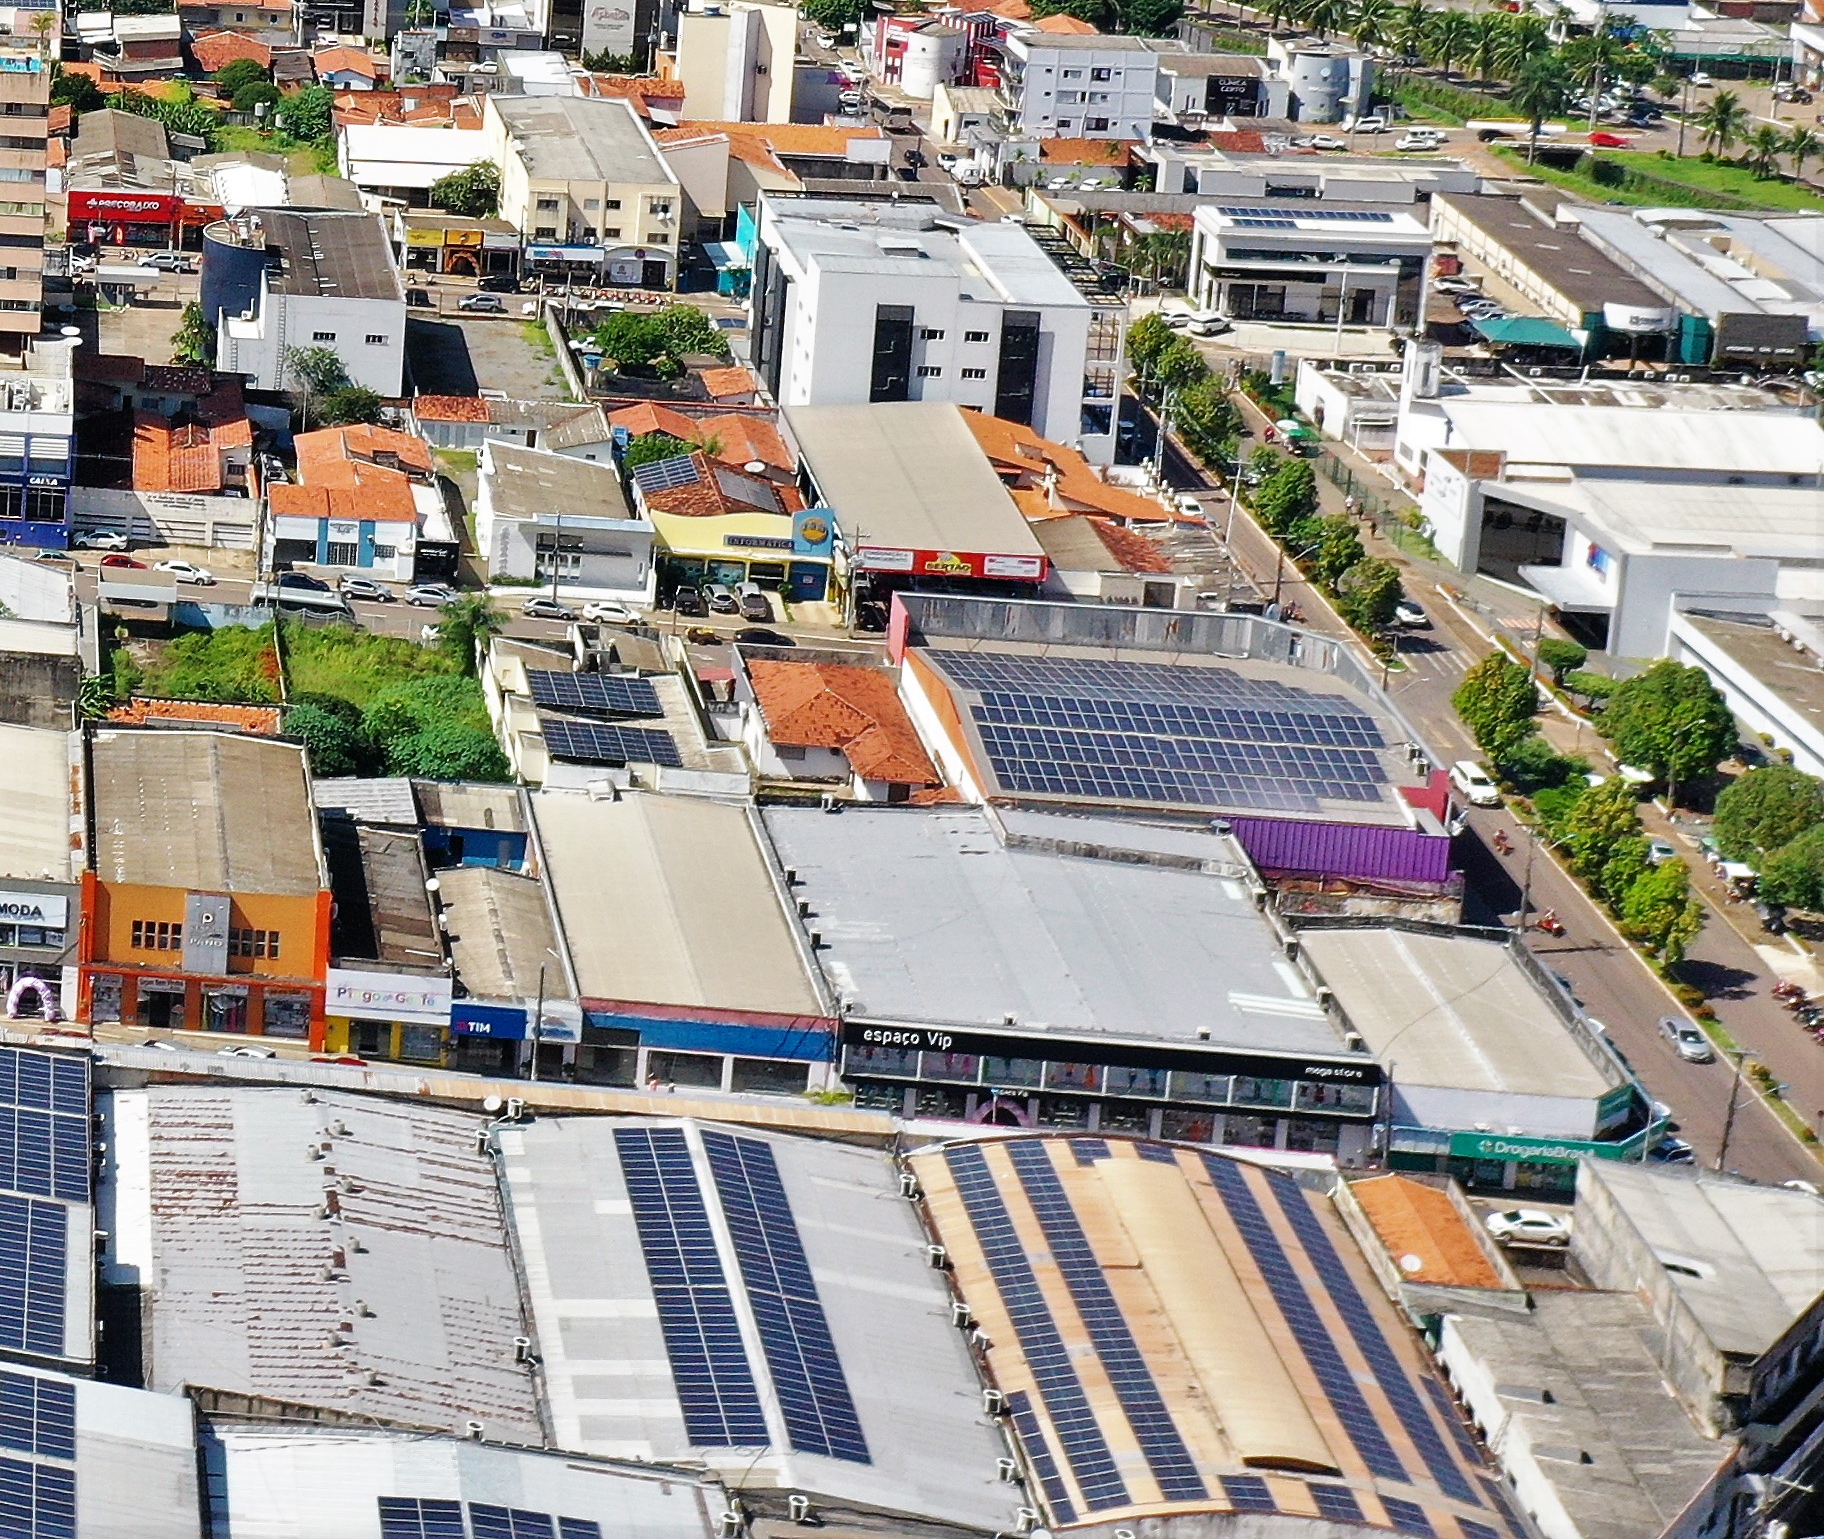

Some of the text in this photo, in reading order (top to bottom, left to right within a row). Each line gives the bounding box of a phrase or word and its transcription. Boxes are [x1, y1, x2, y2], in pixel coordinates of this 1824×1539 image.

[29, 477, 58, 486] CAIXA
[467, 1021, 491, 1034] TIM
[863, 1029, 953, 1050] espaço Vip
